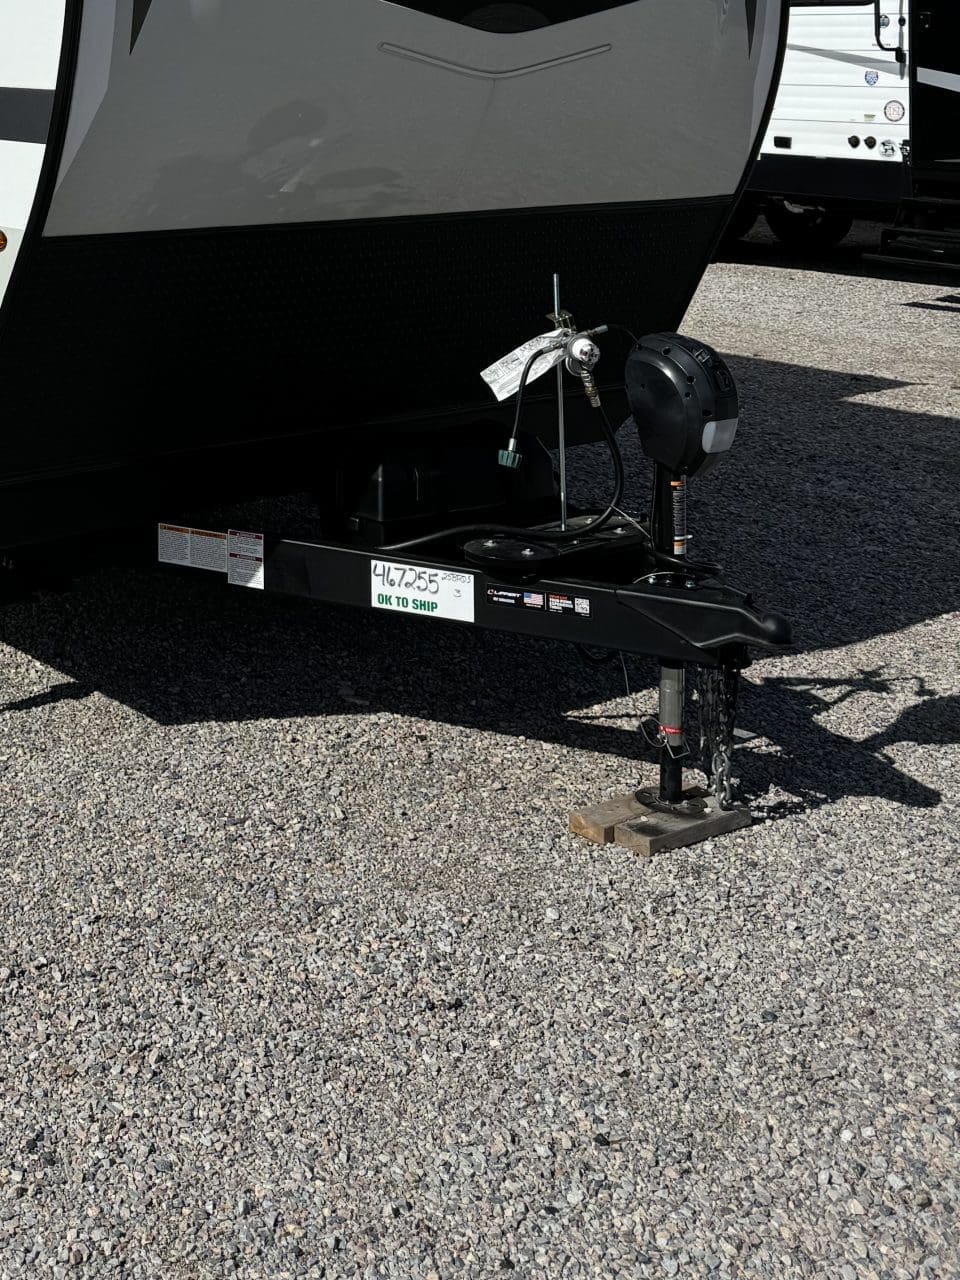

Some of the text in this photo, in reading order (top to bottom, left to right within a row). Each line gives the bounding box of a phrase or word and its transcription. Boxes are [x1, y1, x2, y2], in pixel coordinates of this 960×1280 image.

[373, 563, 439, 594] 467255
[377, 593, 438, 613] OK TO SHIP
